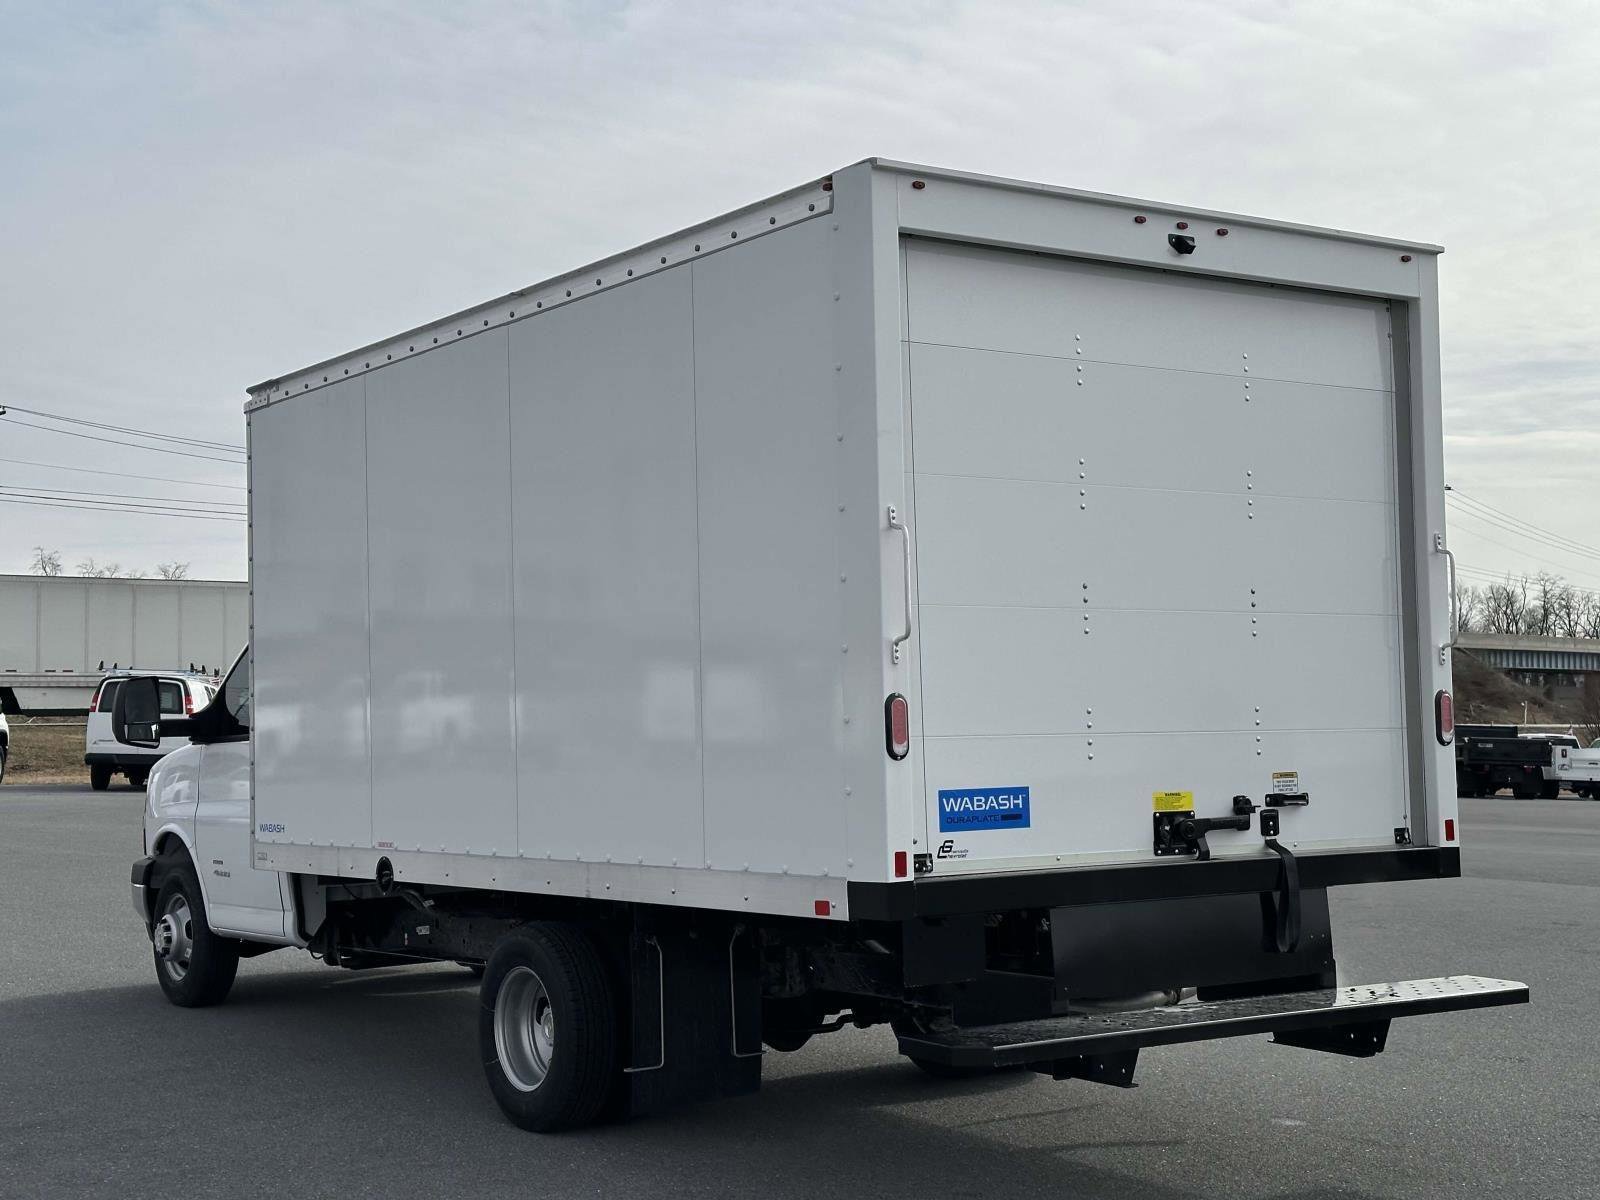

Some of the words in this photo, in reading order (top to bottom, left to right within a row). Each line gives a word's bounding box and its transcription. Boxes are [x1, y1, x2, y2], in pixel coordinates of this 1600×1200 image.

[942, 794, 1023, 812] WABASH
[946, 814, 1000, 824] DURAPLATE
[259, 823, 285, 833] WABASH
